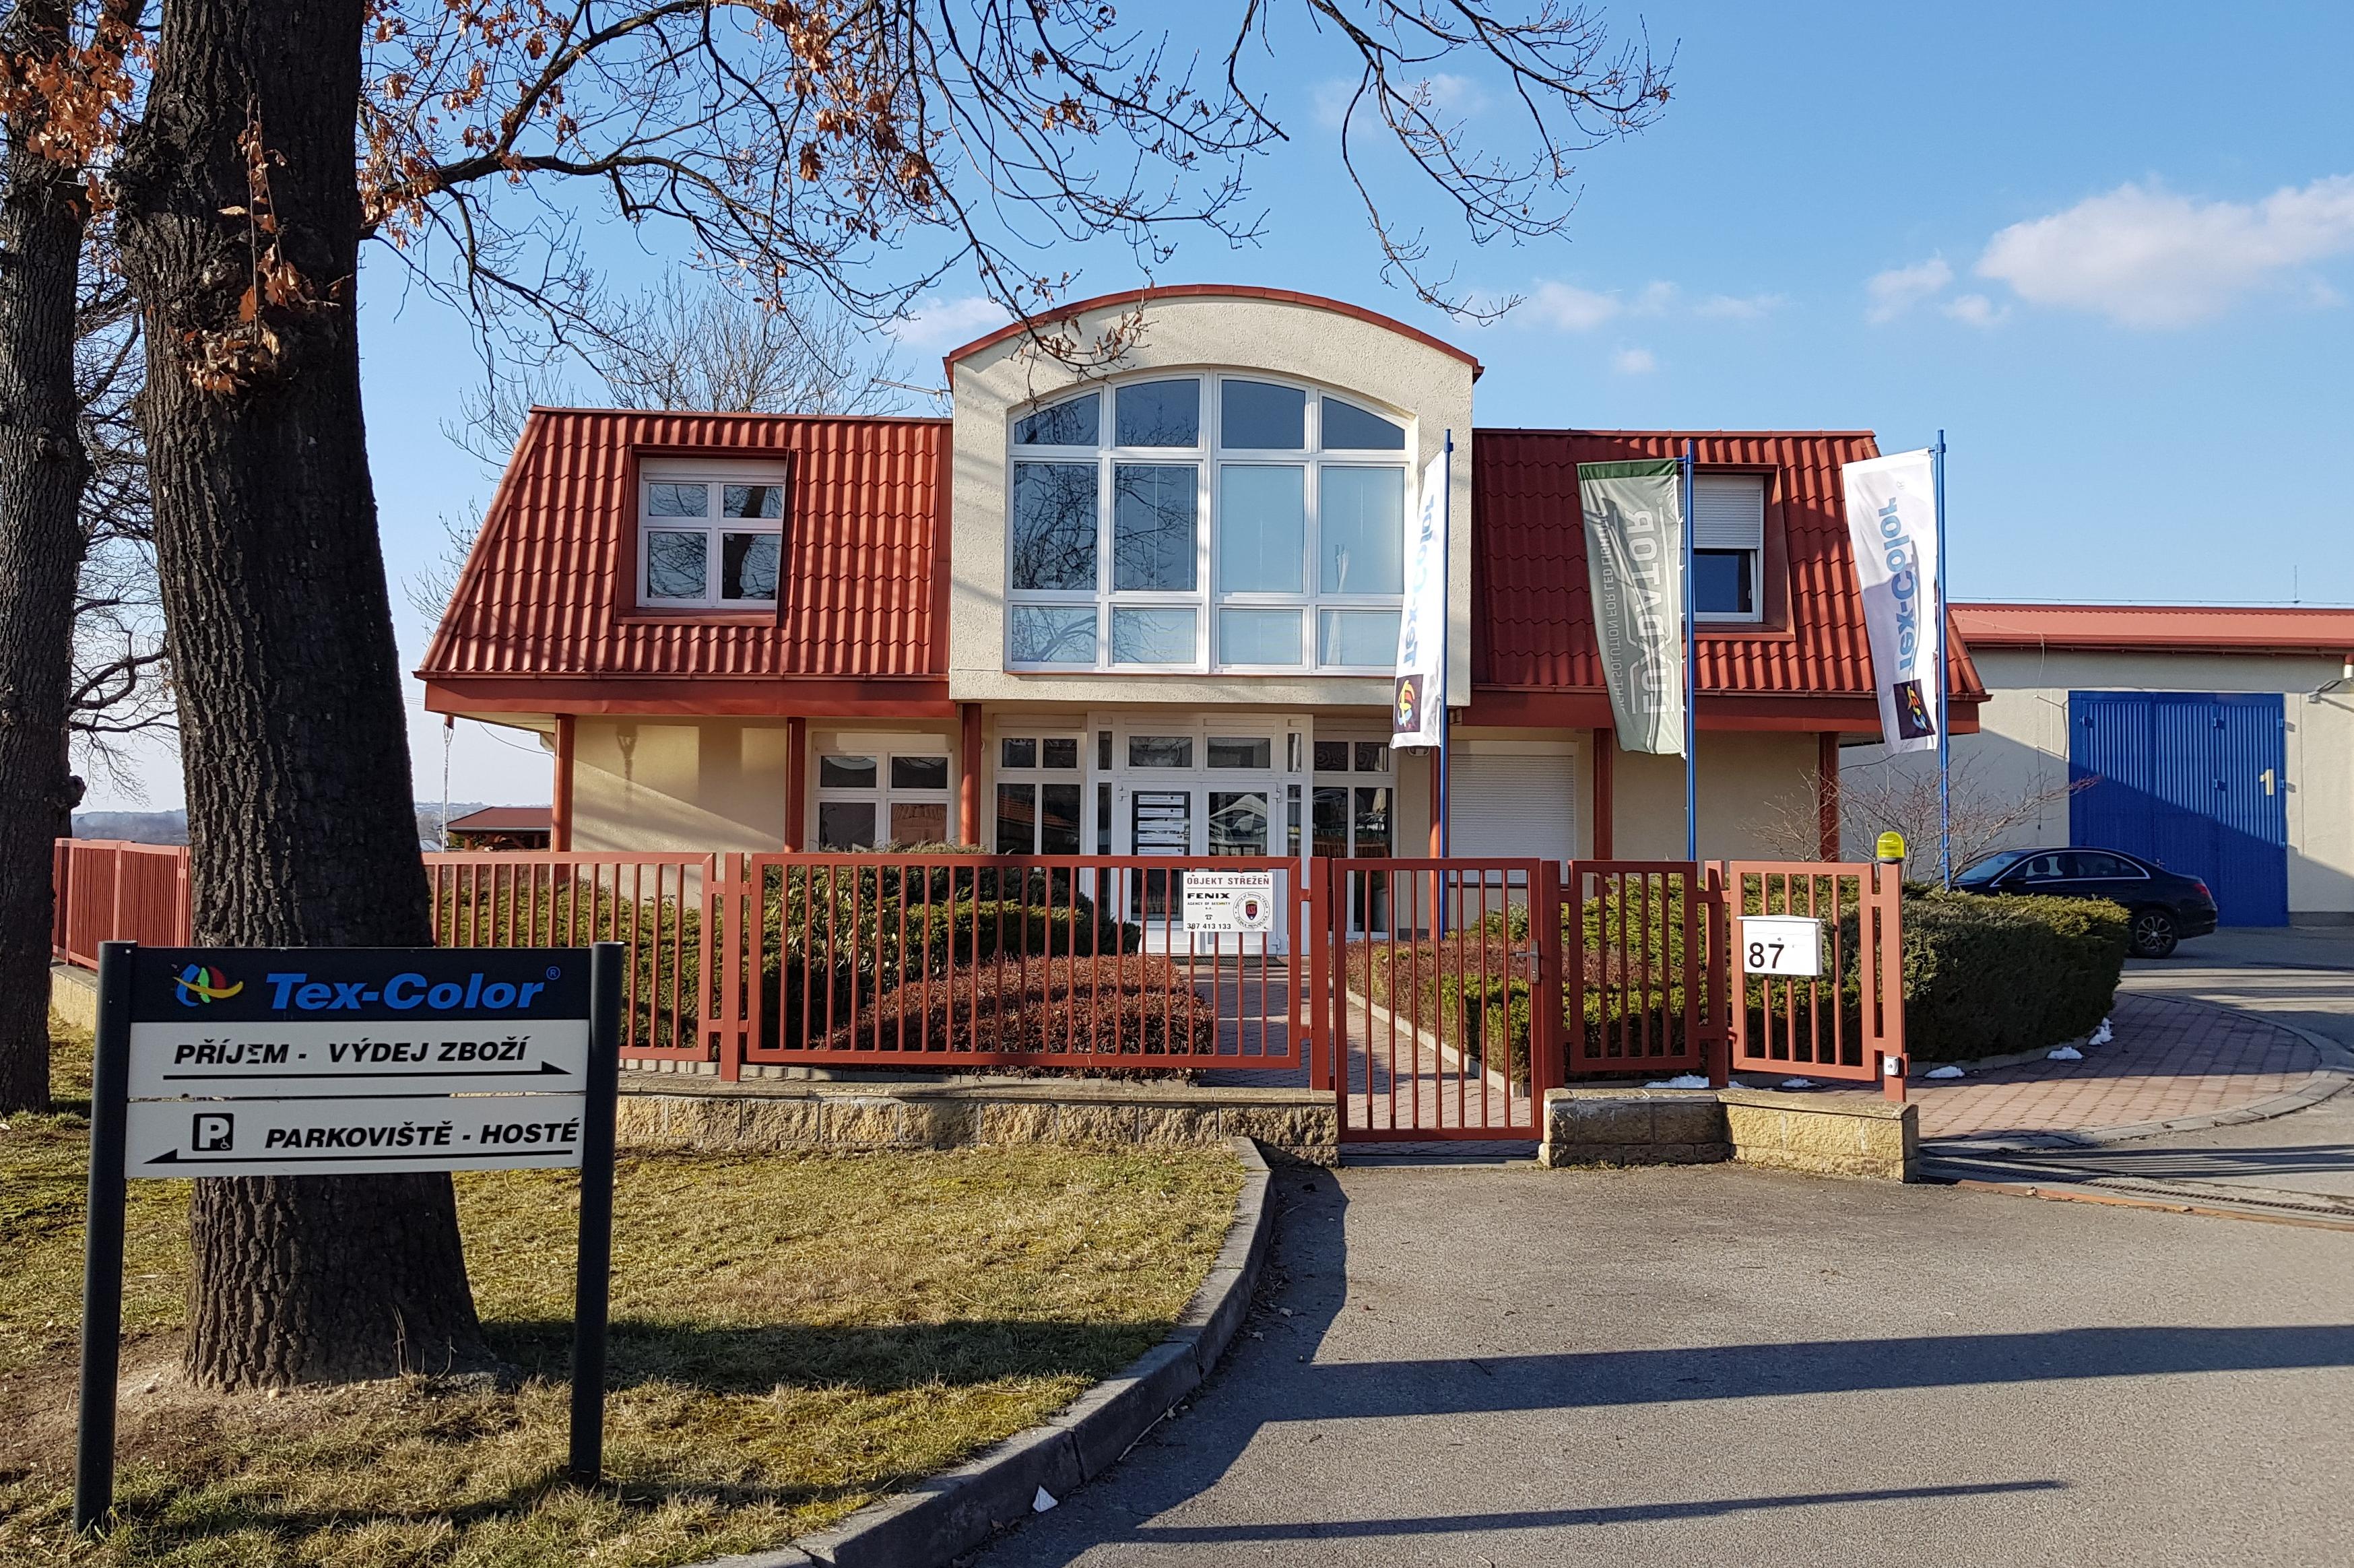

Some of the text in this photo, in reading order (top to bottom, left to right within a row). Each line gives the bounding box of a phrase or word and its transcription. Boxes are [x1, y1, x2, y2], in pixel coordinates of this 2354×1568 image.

[2260, 769, 2275, 795] 1
[1748, 942, 1785, 969] 87
[174, 1039, 290, 1065] PŘÍJEM
[329, 1037, 429, 1062] VÝDEJ
[437, 1035, 533, 1061] ZBOŽÍ
[265, 1119, 454, 1149] PARKOVIŠTĚ
[480, 1117, 581, 1144] HOSTÉ
